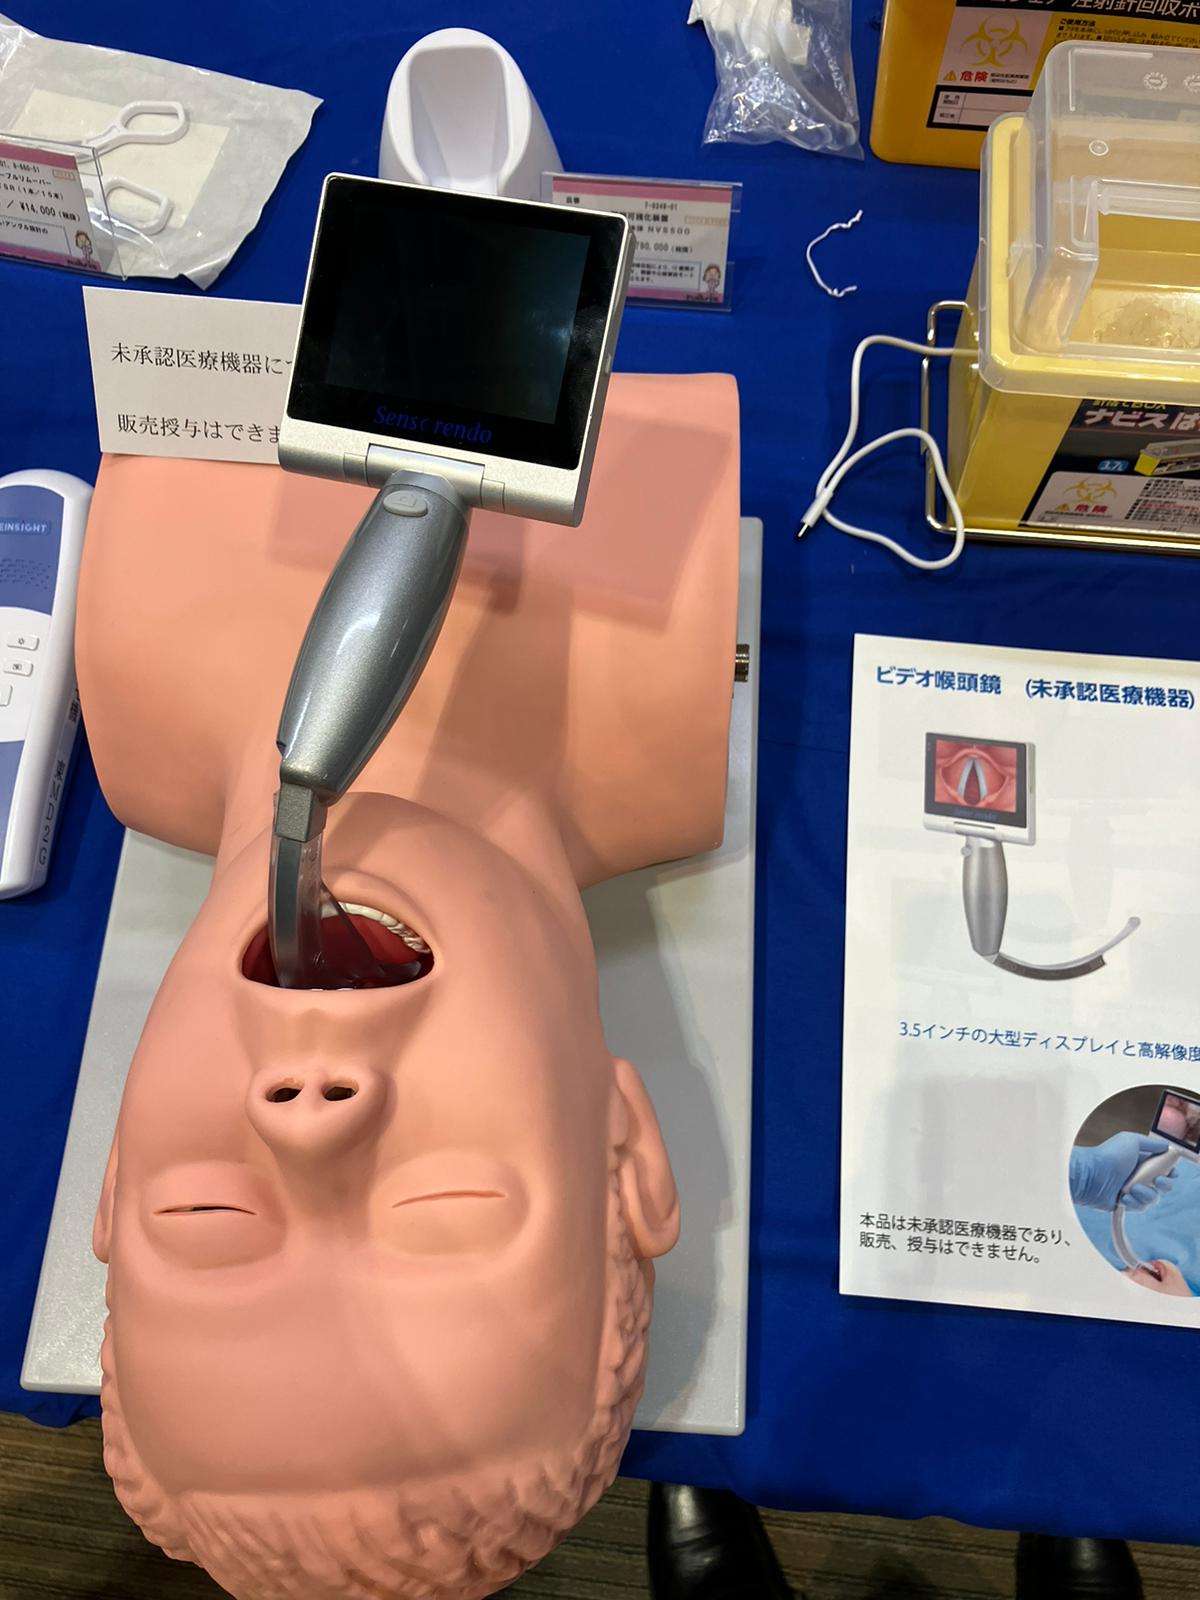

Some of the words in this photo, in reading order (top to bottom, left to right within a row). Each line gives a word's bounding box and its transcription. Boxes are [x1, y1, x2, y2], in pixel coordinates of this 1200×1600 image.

[959, 70, 988, 83] 危険
[111, 342, 294, 375] 未承認医療機器に
[117, 413, 280, 444] 販売授与はできま
[876, 665, 1002, 695] ビデオ喉頭鏡
[899, 1021, 1200, 1063] 3.5インチの大型ディスプレイと高解像度
[859, 1212, 1072, 1247] 本品は未承認医療機器であり、
[859, 1231, 1041, 1264] 販売、授与はできません。
